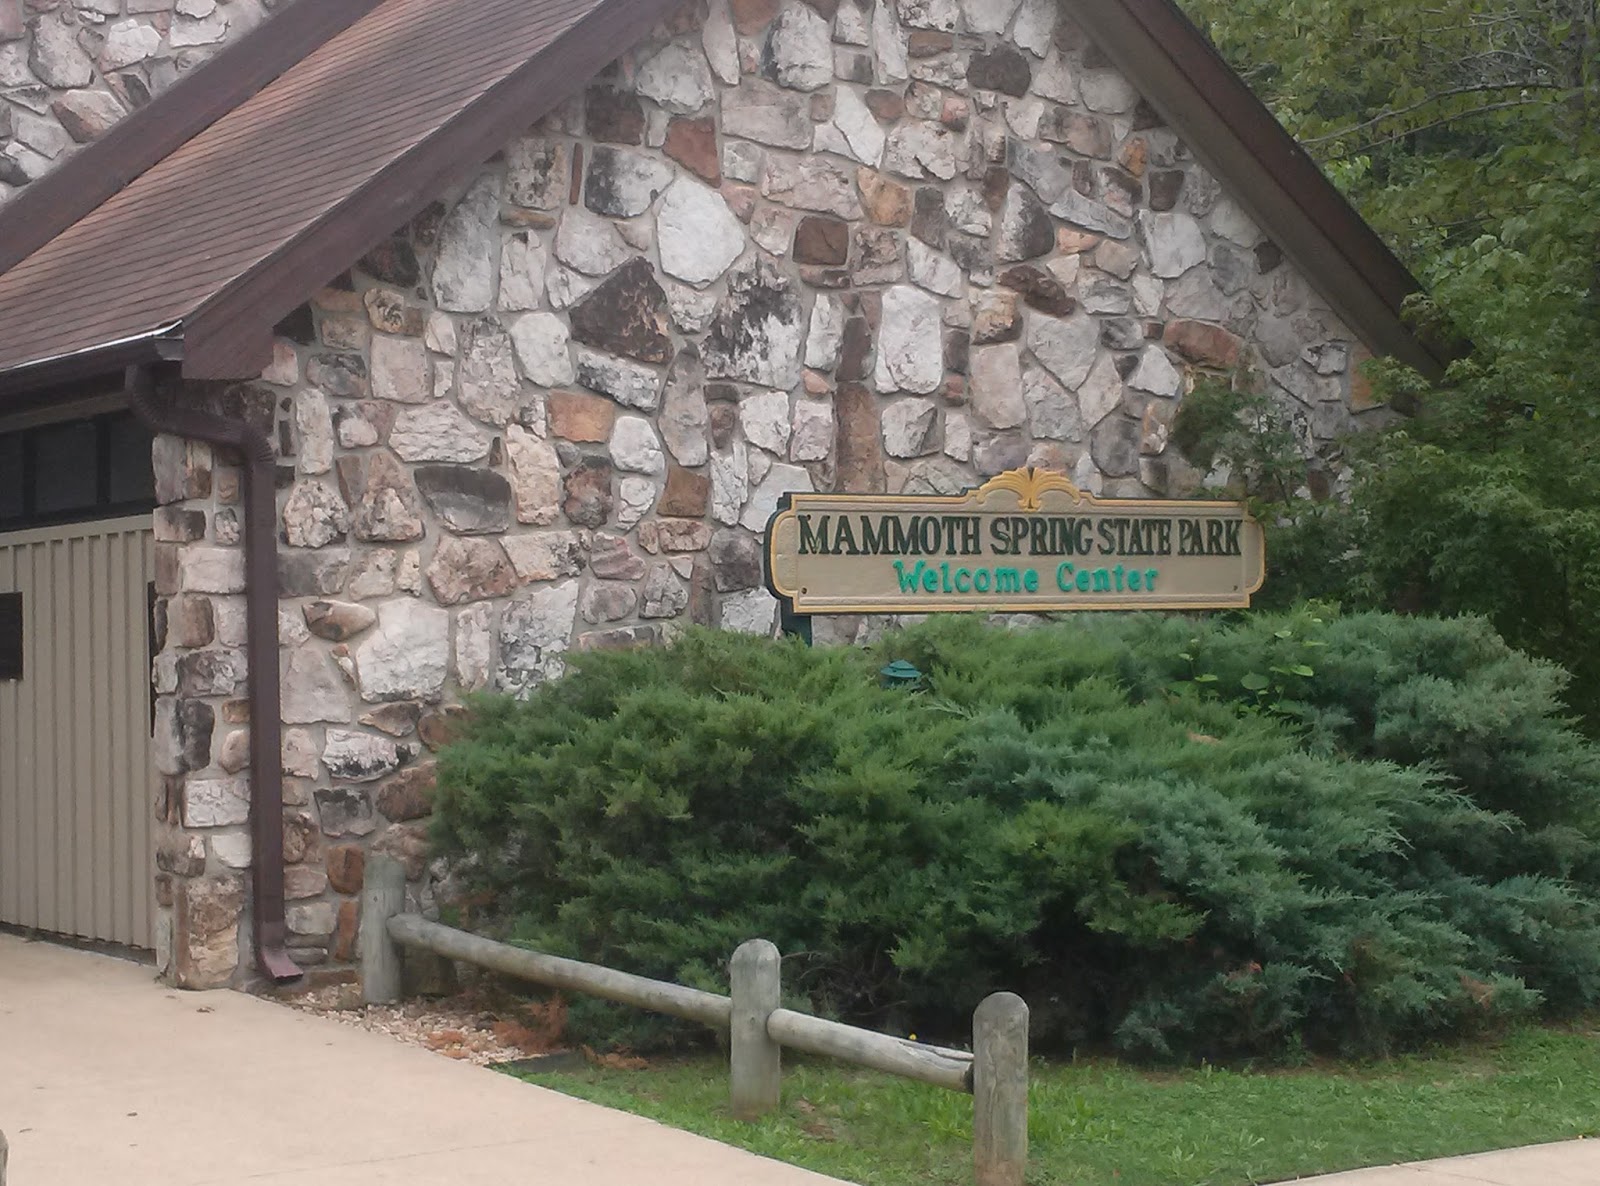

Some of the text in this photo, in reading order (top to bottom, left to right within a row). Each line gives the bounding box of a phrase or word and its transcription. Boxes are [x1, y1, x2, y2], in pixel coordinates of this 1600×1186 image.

[798, 515, 1243, 556] MAMMOTH SPRING STATE PARK
[893, 559, 1159, 593] Welcome Center
